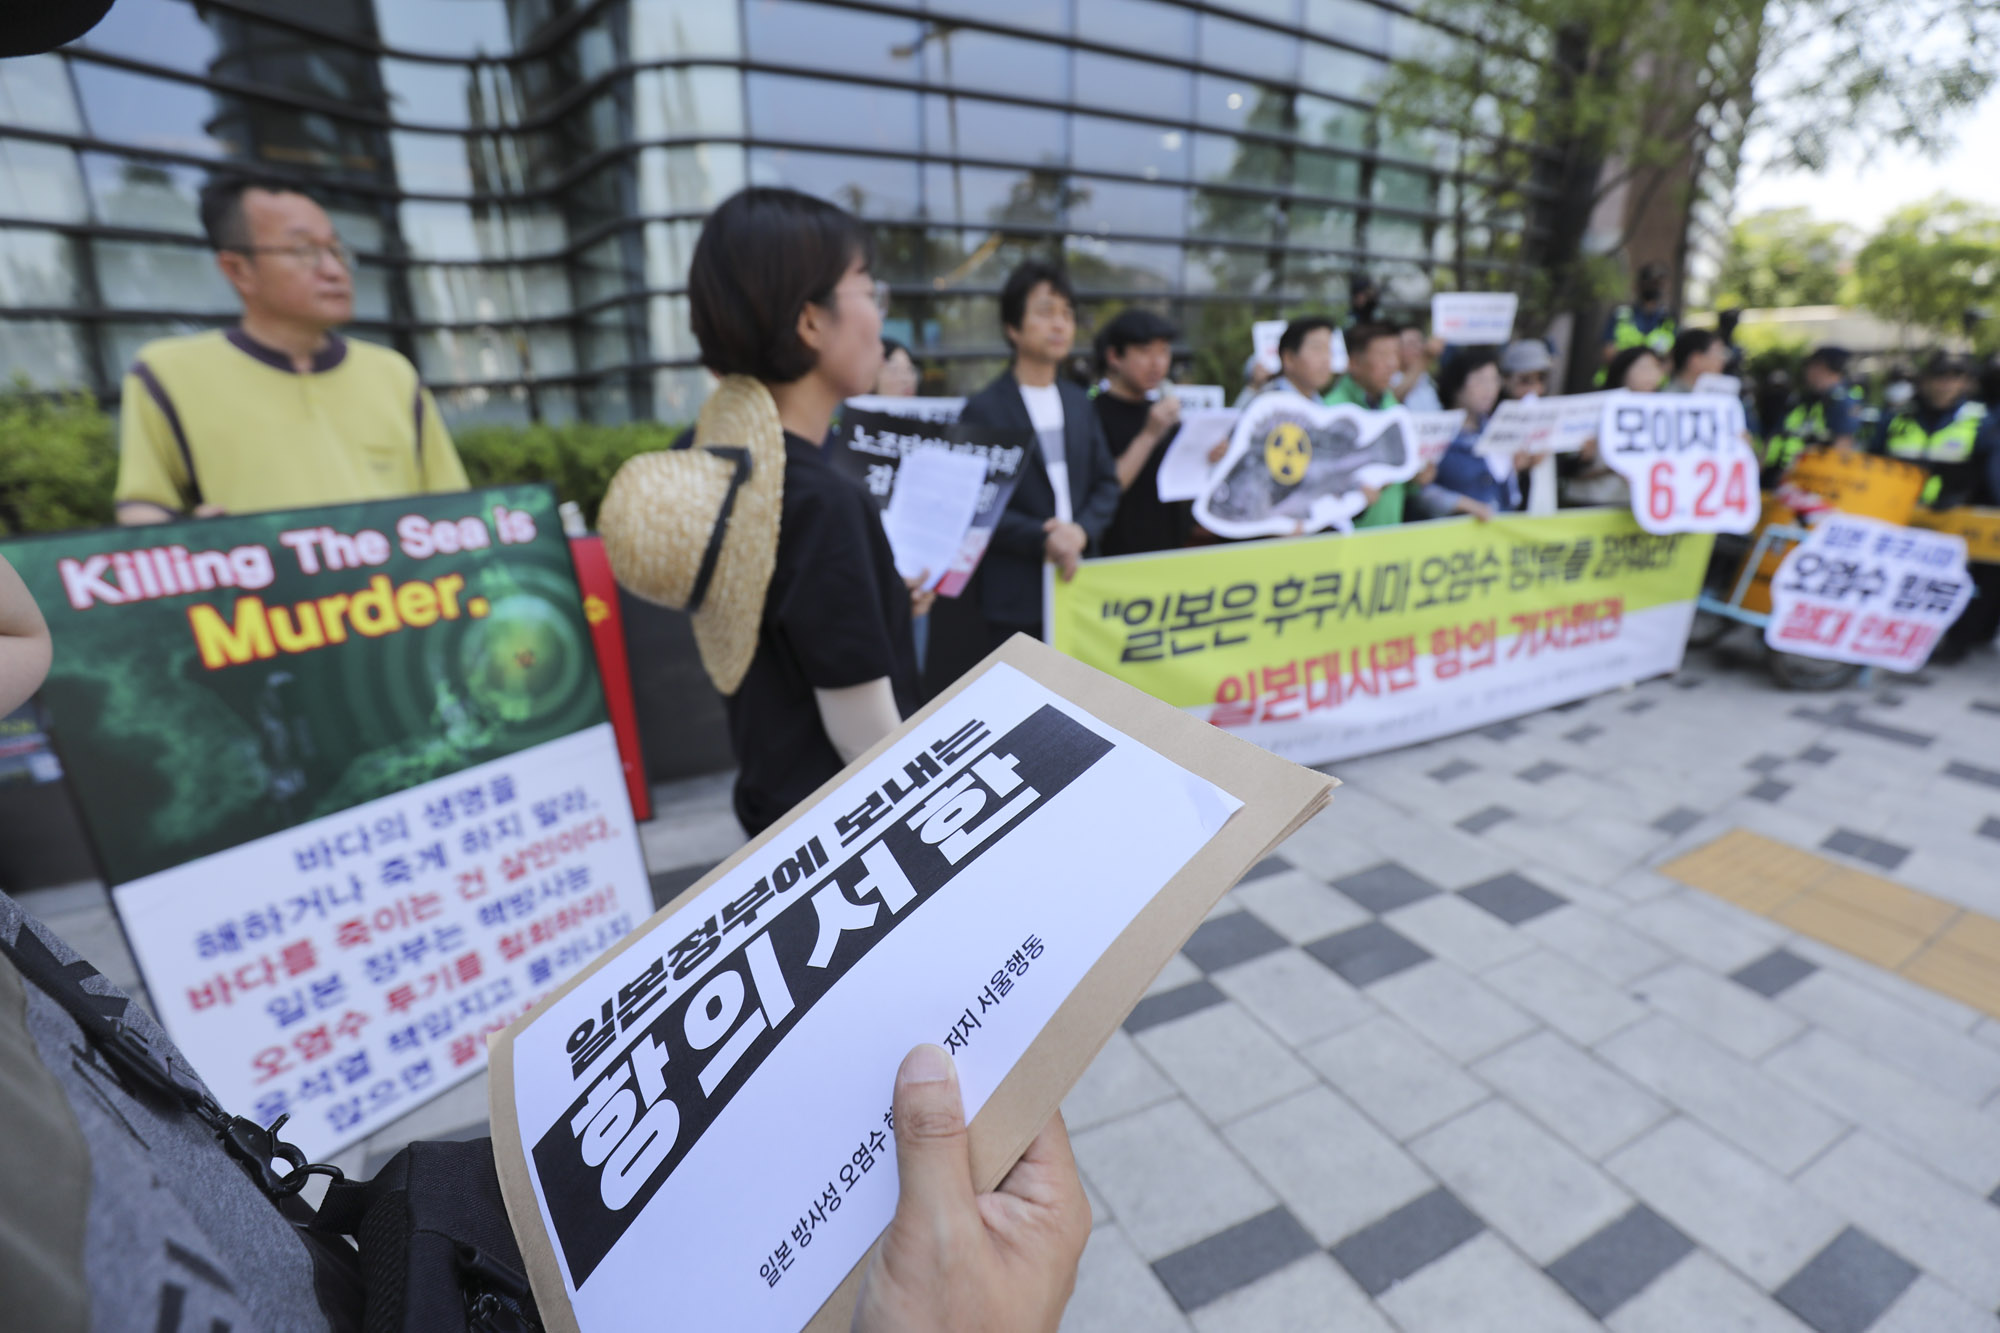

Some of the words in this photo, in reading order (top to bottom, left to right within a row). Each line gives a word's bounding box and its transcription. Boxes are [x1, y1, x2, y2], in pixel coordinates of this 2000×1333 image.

[58, 541, 275, 611] Killing
[280, 523, 390, 577] The
[397, 513, 488, 559] Sea
[491, 505, 537, 546] is
[187, 573, 490, 670] Murder.
[1263, 560, 1413, 636] 후쿠시마
[1415, 546, 1503, 611] 오염수
[1783, 552, 1887, 602] 오염수
[1207, 634, 1418, 729] 일본대사관
[1431, 618, 1497, 680] 항의
[1507, 593, 1625, 661] 기자회견
[195, 871, 365, 960] 해하거나
[379, 841, 447, 886] 죽게
[459, 809, 525, 855] 하지
[294, 811, 411, 872] 바다의
[565, 835, 829, 1081] 일본정부에
[834, 719, 991, 848] 보내는
[185, 937, 319, 1013] 바다를
[334, 892, 444, 948] 죽이는
[455, 864, 489, 901] 건
[499, 813, 622, 882] 살인이다.
[265, 970, 348, 1030] 일본
[363, 922, 467, 986] 정부는
[252, 1008, 372, 1087] 오염수
[386, 950, 483, 1014] 투기를
[388, 975, 516, 1054] 책임지고
[527, 911, 634, 988] 물러나지
[570, 752, 1041, 1211] 항의서한
[759, 1239, 796, 1288] 일본
[790, 1182, 842, 1248] 방사성
[838, 1128, 887, 1193] 오염수
[943, 1008, 981, 1056] 저지
[980, 933, 1045, 1014] 서울행동
